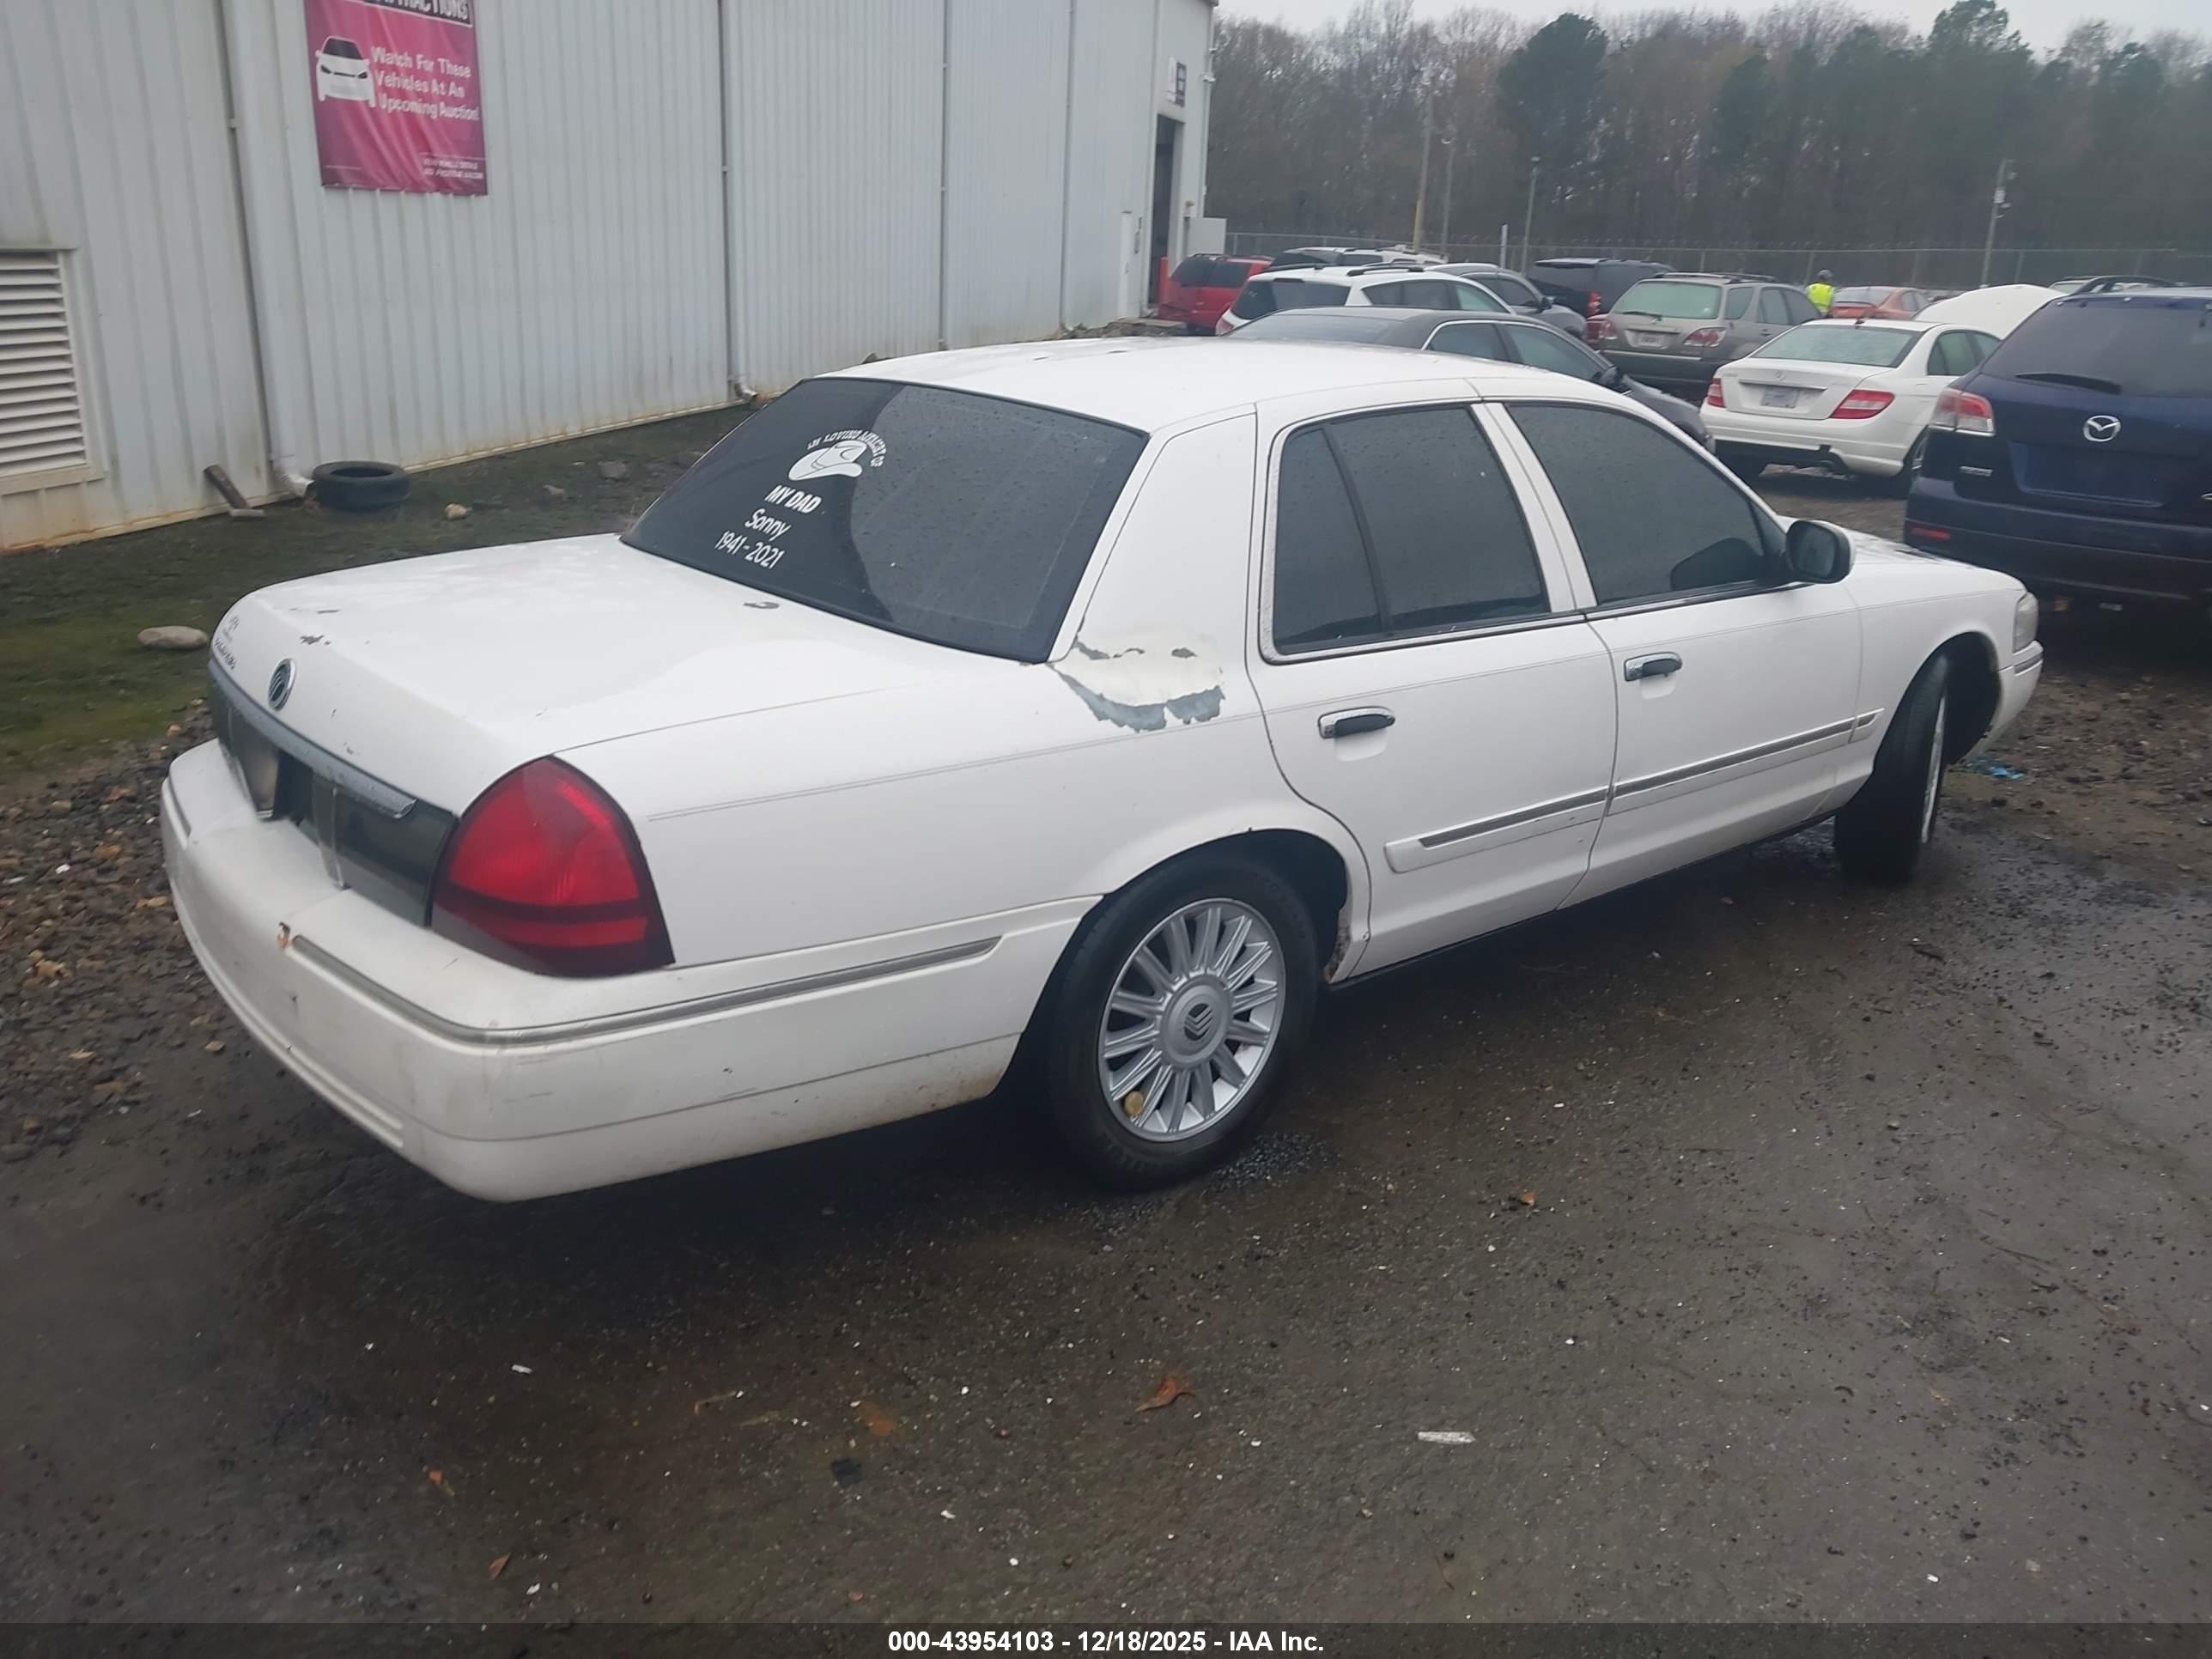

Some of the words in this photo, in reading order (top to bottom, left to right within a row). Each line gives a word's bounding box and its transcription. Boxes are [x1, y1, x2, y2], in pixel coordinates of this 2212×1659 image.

[371, 46, 412, 68] Watch
[416, 54, 434, 72] For
[437, 57, 471, 78] These
[374, 70, 428, 93] Vehicles
[431, 79, 446, 95] At
[448, 82, 465, 98] An
[379, 93, 438, 119] Upcoming
[764, 484, 797, 505] MY
[784, 490, 822, 514] DAD
[744, 507, 792, 542] Sonny
